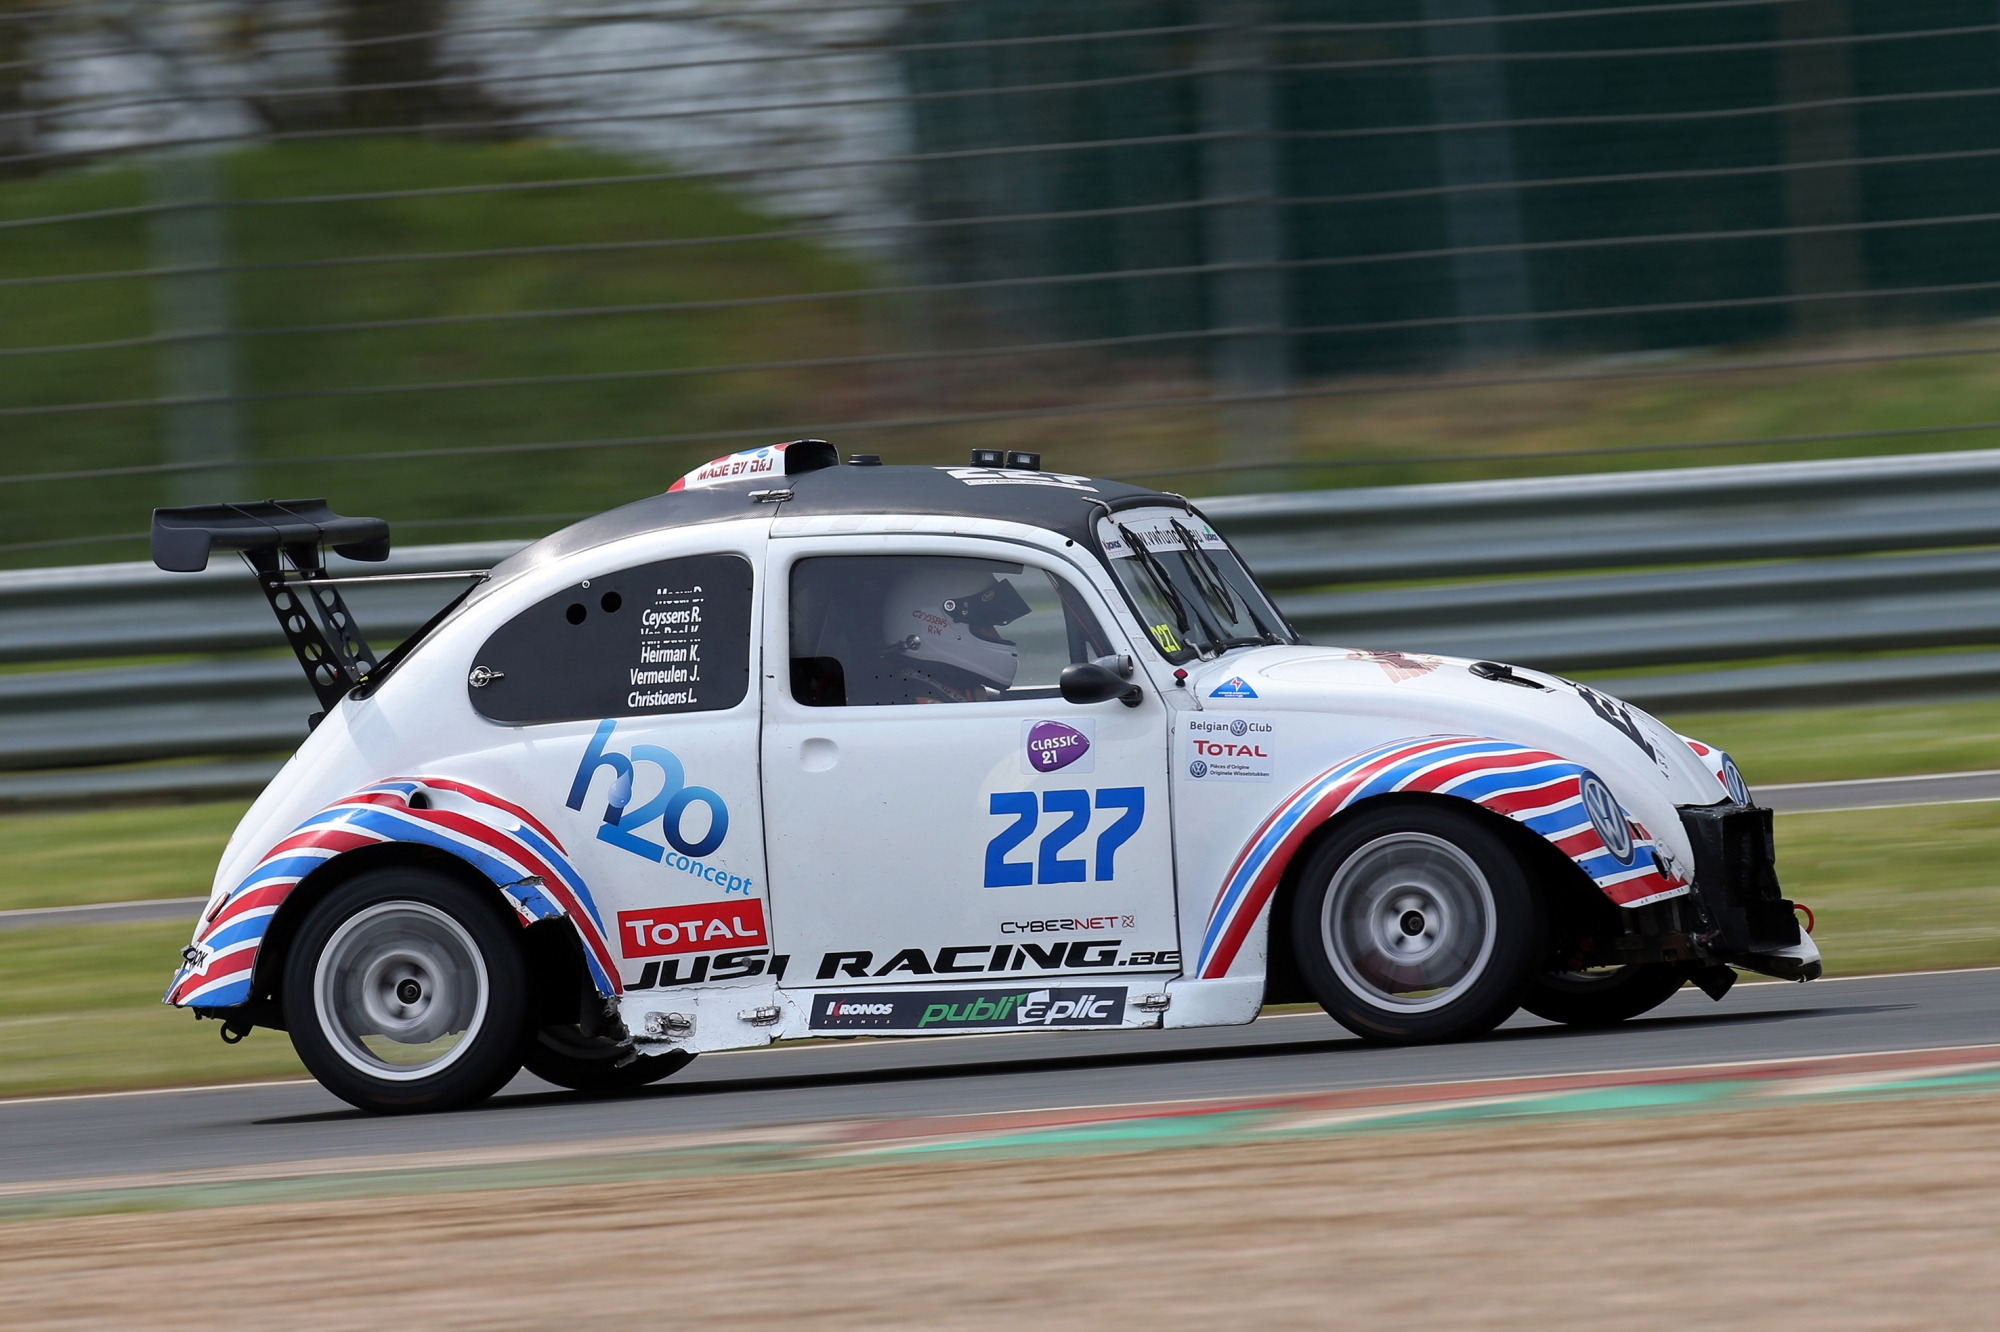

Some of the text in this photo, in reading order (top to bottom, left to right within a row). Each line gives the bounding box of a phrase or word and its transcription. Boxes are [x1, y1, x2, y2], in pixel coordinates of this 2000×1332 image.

[697, 458, 774, 481] MADE BY D&J
[642, 606, 702, 629] Ceyssens R.
[641, 644, 700, 663] Heirman K.
[630, 664, 700, 685] Vermeulen J.
[627, 688, 697, 708] Christiaens L.
[1190, 721, 1229, 733] Belgian
[1249, 723, 1272, 732] Club
[1030, 734, 1079, 751] CLASSIC
[1193, 740, 1268, 757] TOTAL
[1042, 751, 1058, 764] 21
[984, 786, 1145, 888] 227
[665, 852, 752, 895] concept
[625, 916, 759, 947] TOTAL
